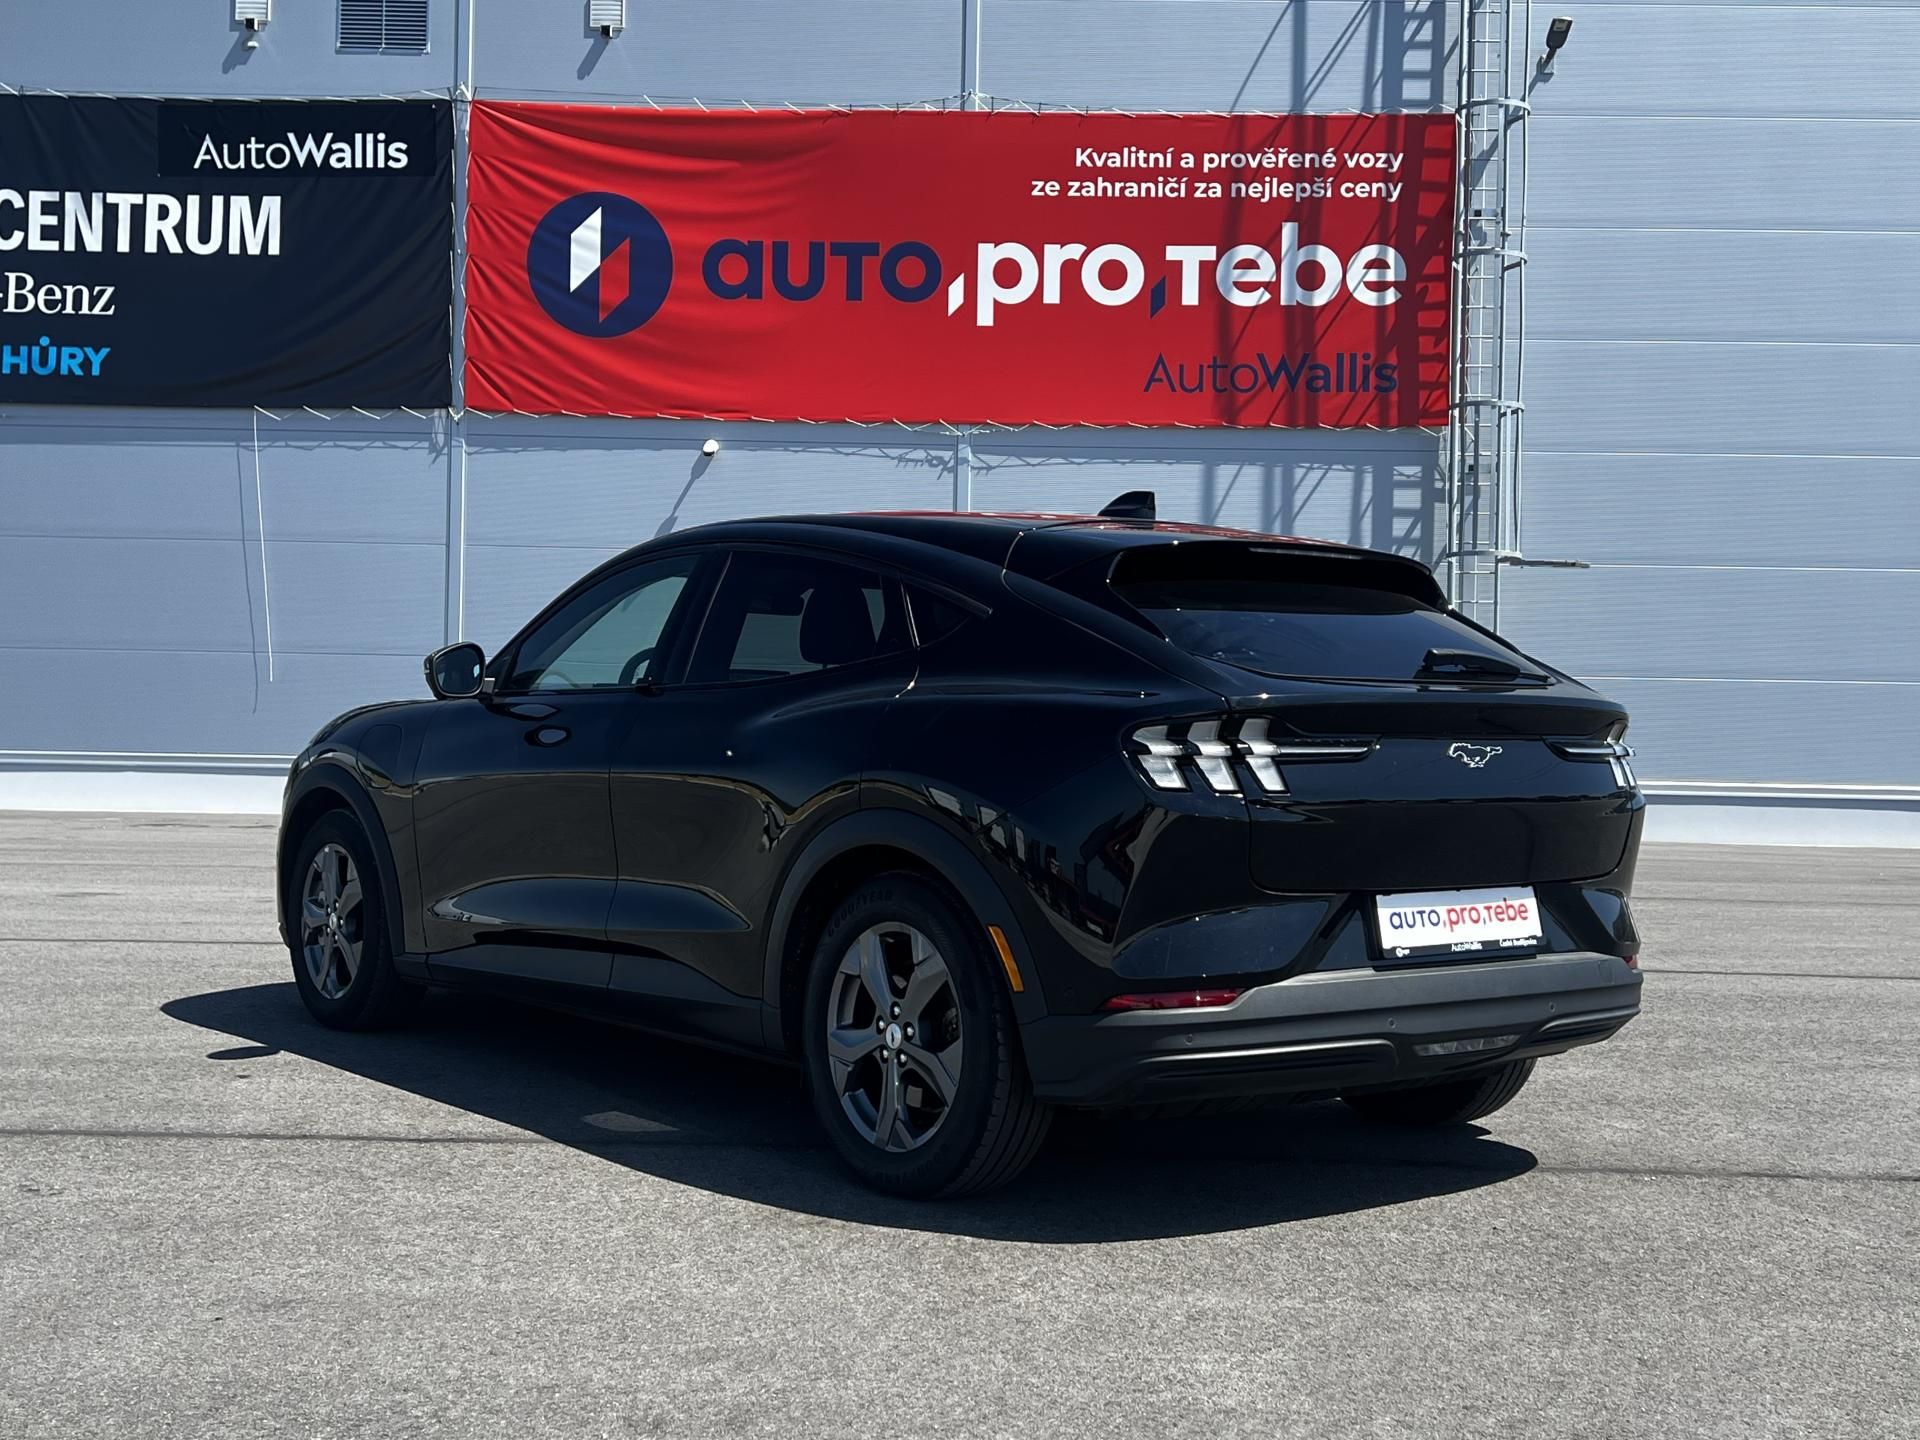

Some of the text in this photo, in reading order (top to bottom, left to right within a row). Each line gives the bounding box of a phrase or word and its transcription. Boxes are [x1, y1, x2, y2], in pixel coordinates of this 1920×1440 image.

[193, 132, 409, 170] AutoWallis
[1075, 146, 1404, 174] Kvalitní a prověřené vozy
[1031, 176, 1403, 202] ze zahraničí za nejlepší ceny
[1143, 352, 1399, 394] AutoWallis
